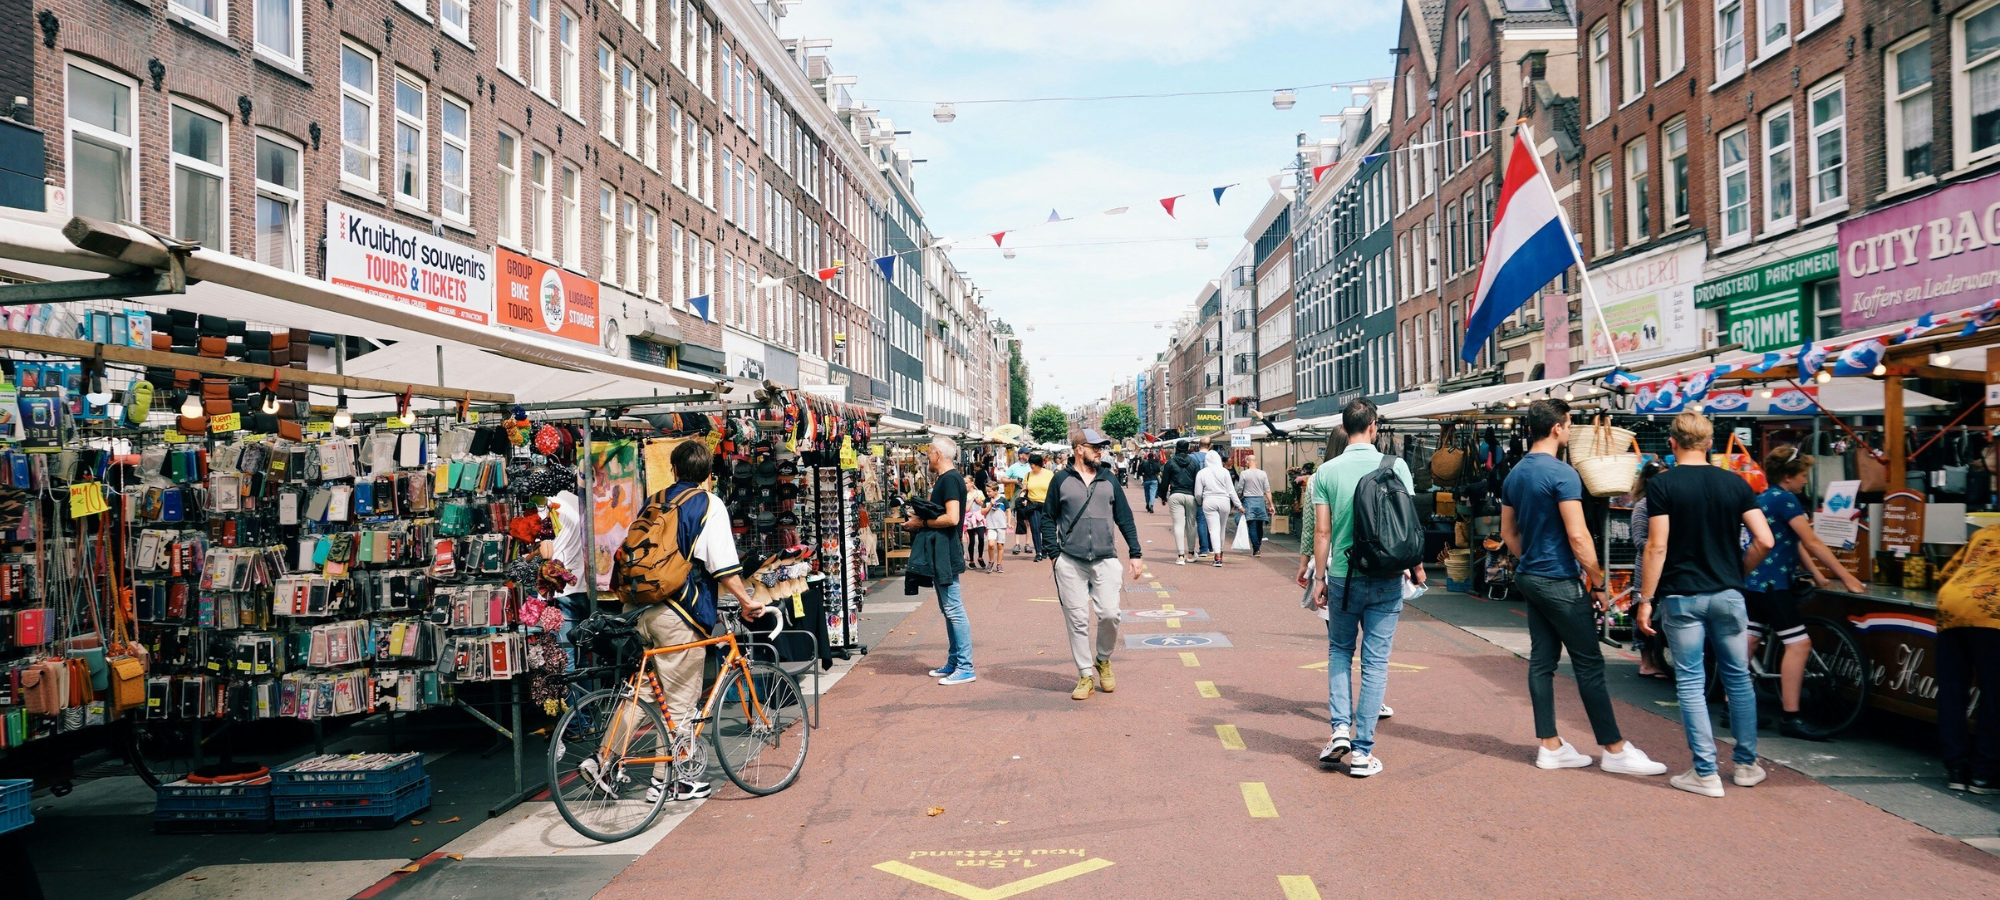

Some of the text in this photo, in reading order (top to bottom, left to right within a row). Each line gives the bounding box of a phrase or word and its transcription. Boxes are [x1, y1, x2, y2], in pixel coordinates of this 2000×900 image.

[349, 214, 486, 281] Kruithof souvenirs
[1848, 224, 1922, 278] CITY
[366, 253, 467, 303] TOURS & TICKETS
[507, 259, 533, 280] GROUP
[1607, 255, 1680, 296] SLAGERIJ
[511, 281, 529, 301] BIKE
[1695, 272, 1759, 303] DROGISTERIJ
[569, 290, 594, 309] LUGGAGE
[1852, 285, 1902, 319] Koffers
[1906, 285, 1922, 303] en
[460, 311, 483, 322] ATTRACTIONS
[508, 302, 533, 323] TOURS
[569, 310, 595, 329] STORAGE
[1730, 309, 1800, 352] GRIMME
[144, 545, 153, 558] 7
[909, 848, 1086, 860] hou afstand
[955, 857, 1038, 869] 1,5m
